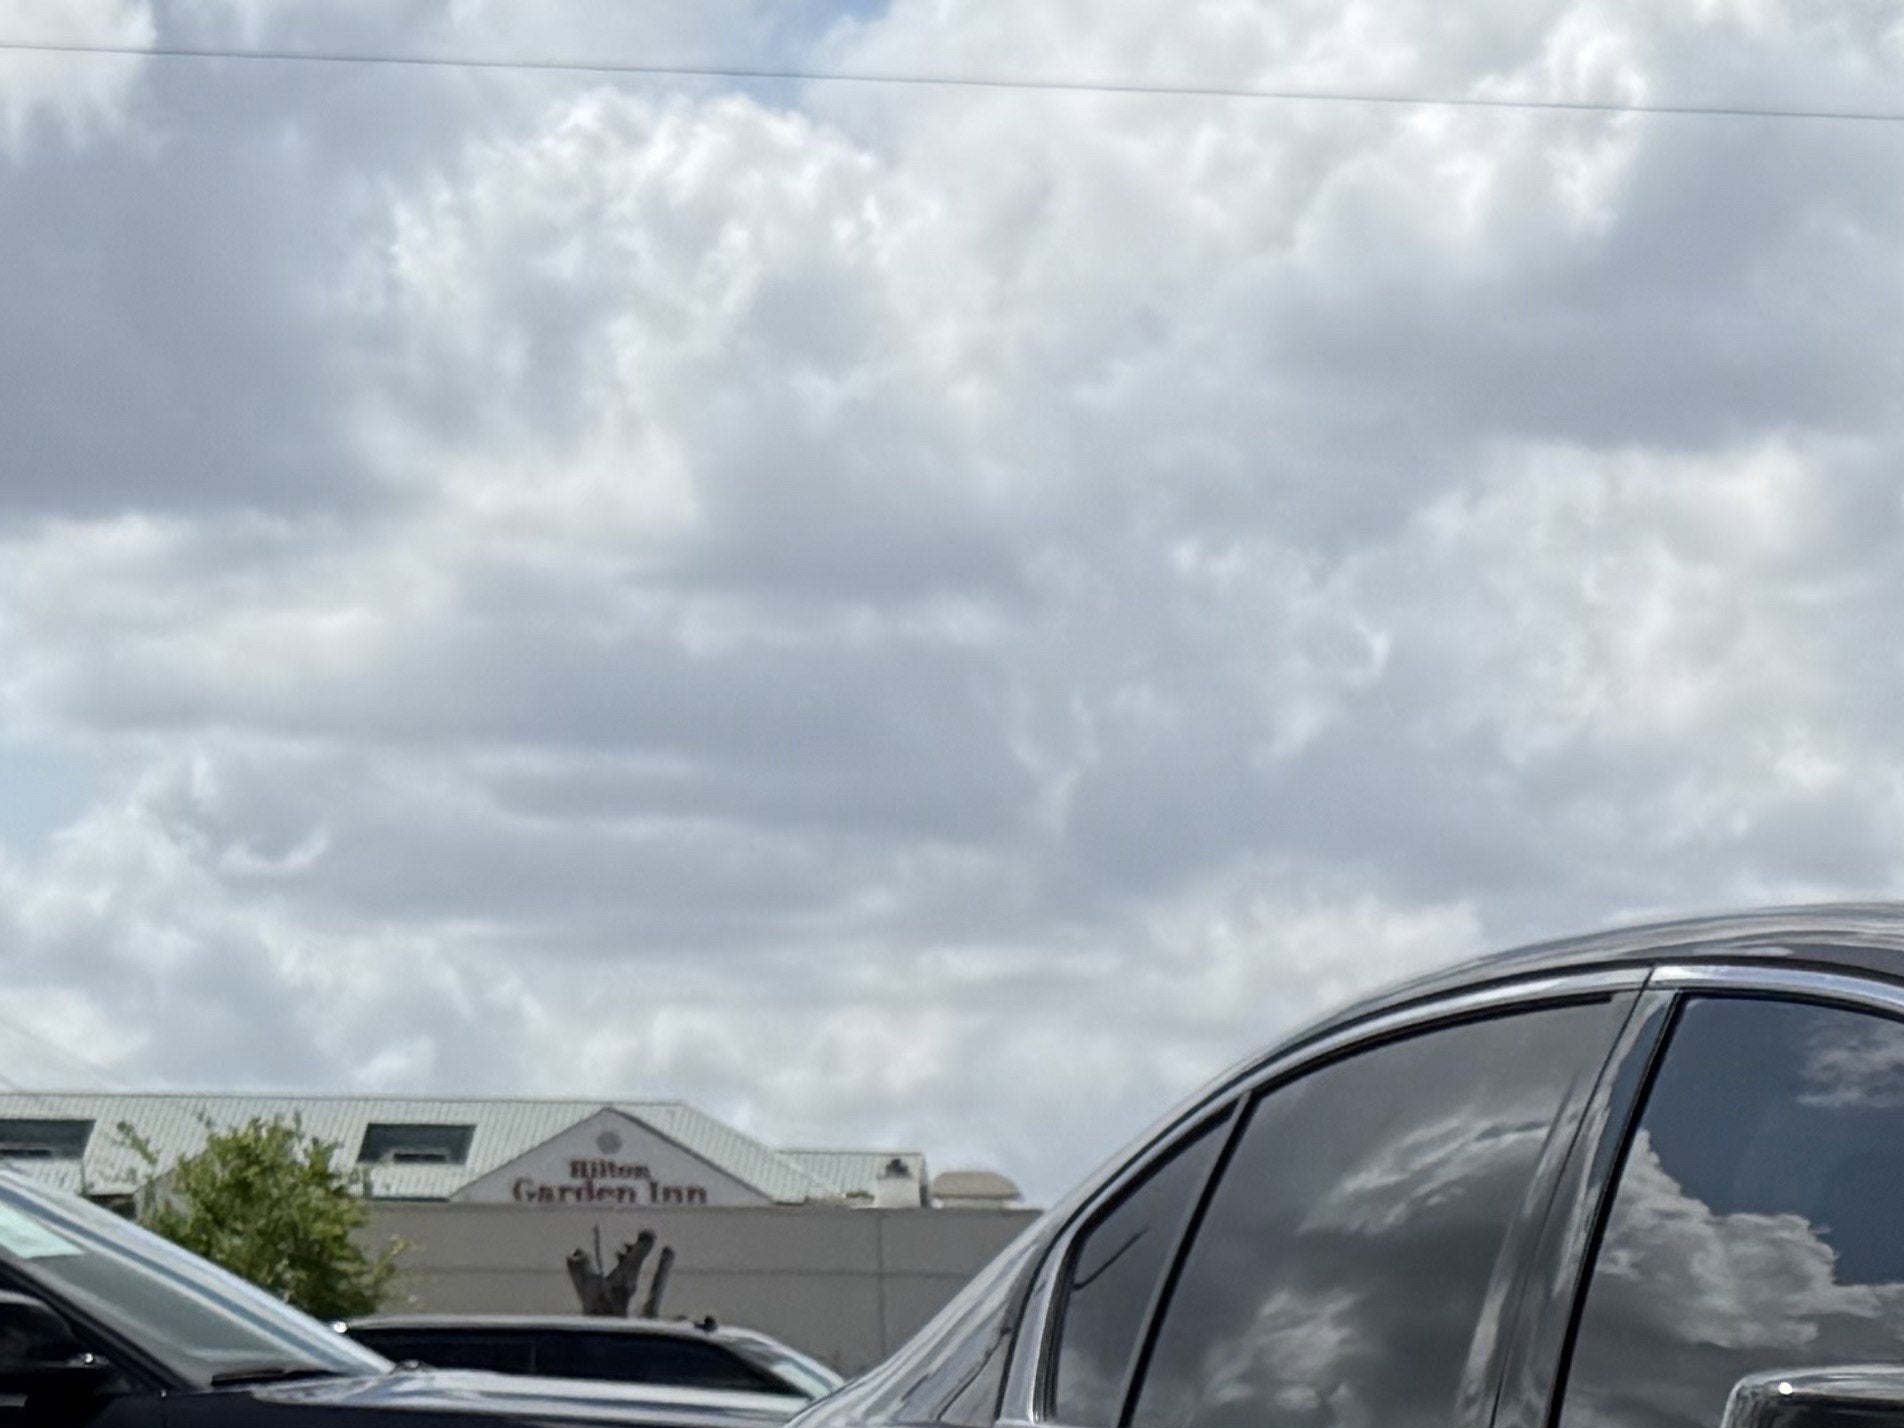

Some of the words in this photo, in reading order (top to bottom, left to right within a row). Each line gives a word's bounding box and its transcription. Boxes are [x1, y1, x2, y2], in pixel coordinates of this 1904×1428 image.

[569, 1159, 650, 1179] Hilton
[513, 1178, 637, 1202] Garden
[650, 1181, 707, 1202] Inn
